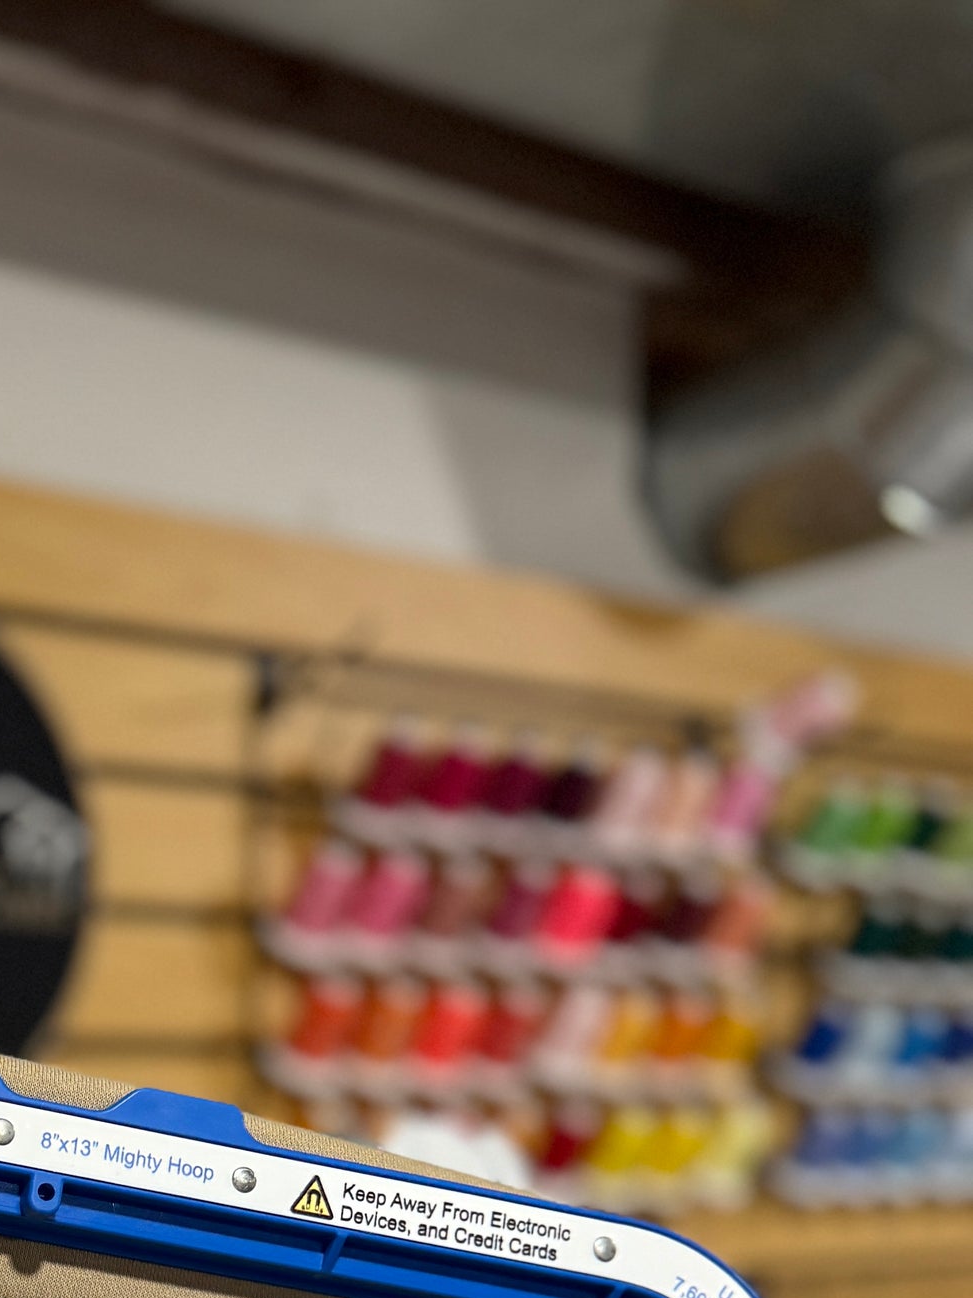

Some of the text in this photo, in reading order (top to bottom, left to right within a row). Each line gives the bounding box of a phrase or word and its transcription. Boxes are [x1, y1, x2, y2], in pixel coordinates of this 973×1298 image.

[103, 1143, 163, 1174] Mighty
[167, 1155, 215, 1184] Hoop
[340, 1206, 558, 1262] Devices, and Credit Cards
[342, 1182, 572, 1243] Keep Away From Electronic
